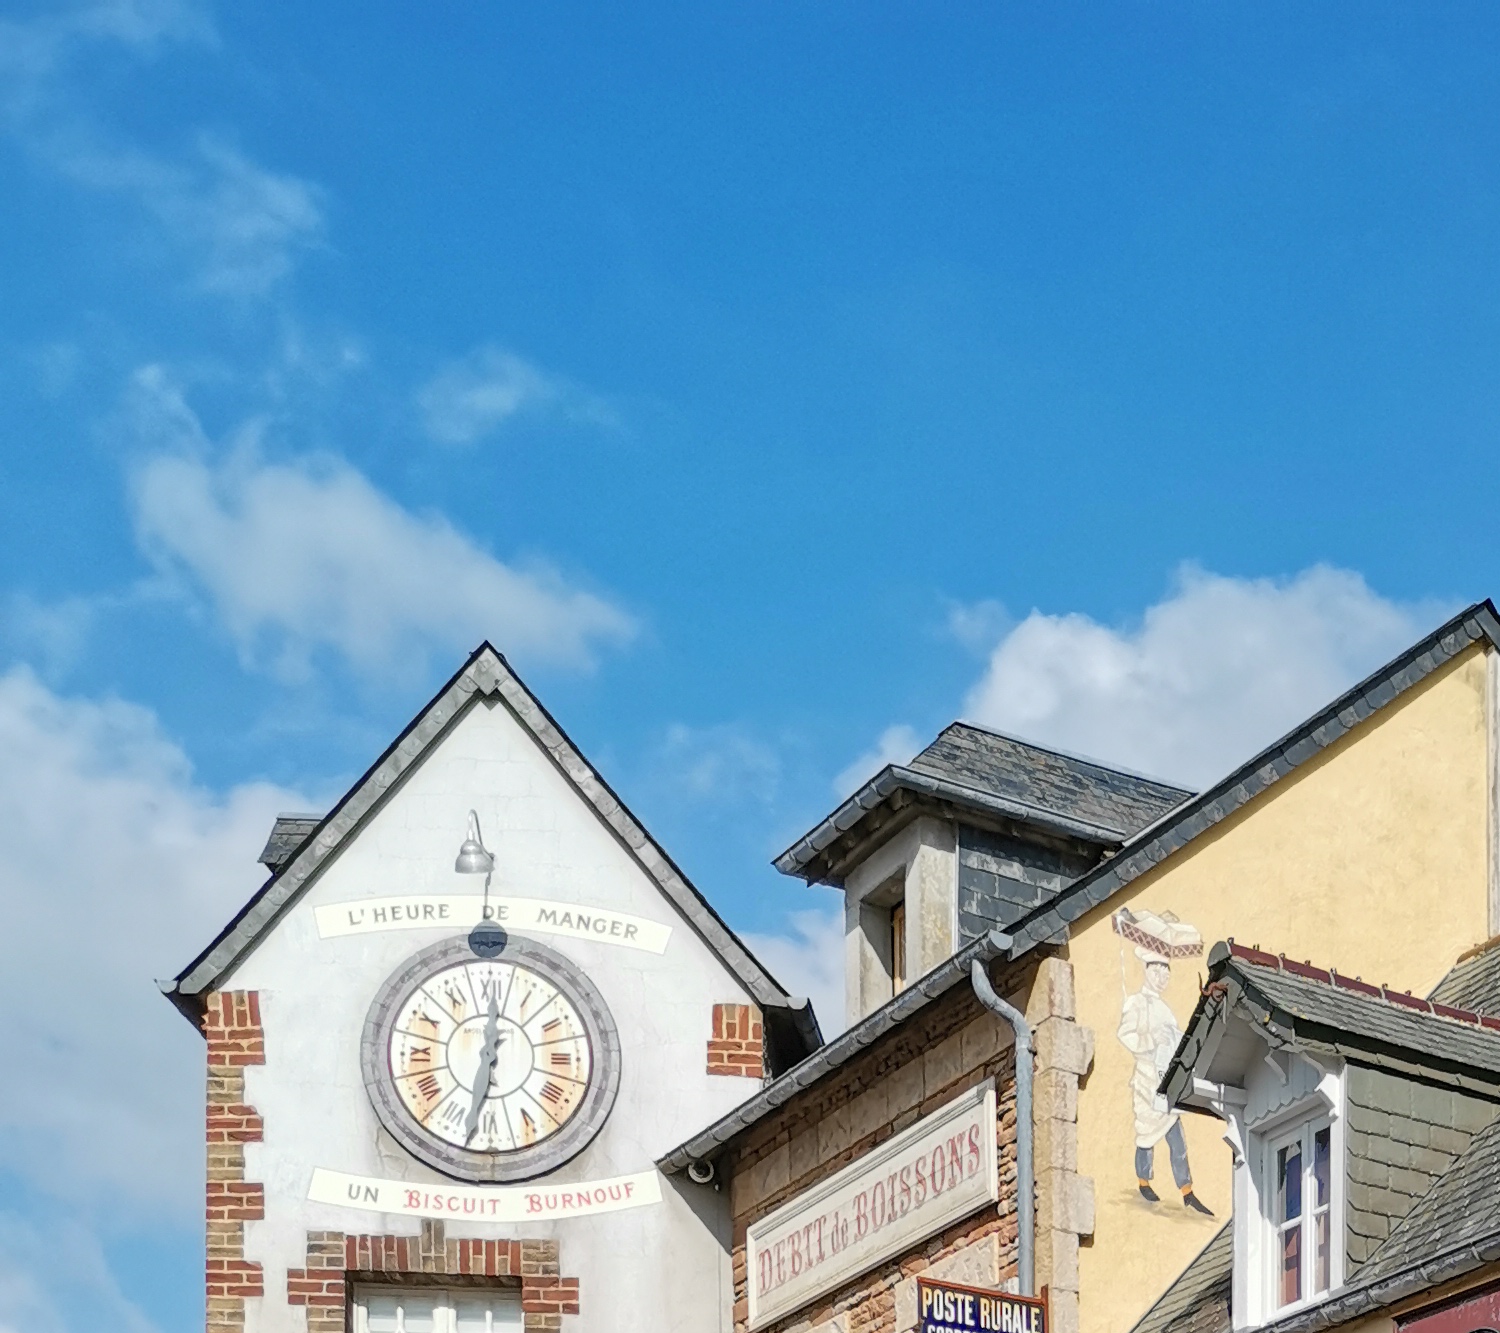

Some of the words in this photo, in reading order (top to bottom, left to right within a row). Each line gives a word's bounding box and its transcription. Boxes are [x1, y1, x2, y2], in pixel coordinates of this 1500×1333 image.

[482, 905, 510, 921] DE
[536, 908, 639, 941] MANGER
[347, 1184, 379, 1202] UN
[404, 1189, 501, 1215] BISCUIT
[525, 1182, 636, 1213] BURNOUF
[758, 1214, 826, 1294] DEBIT
[831, 1210, 848, 1254] de
[852, 1123, 981, 1242] BOISSONS
[922, 1286, 975, 1327] POSTE
